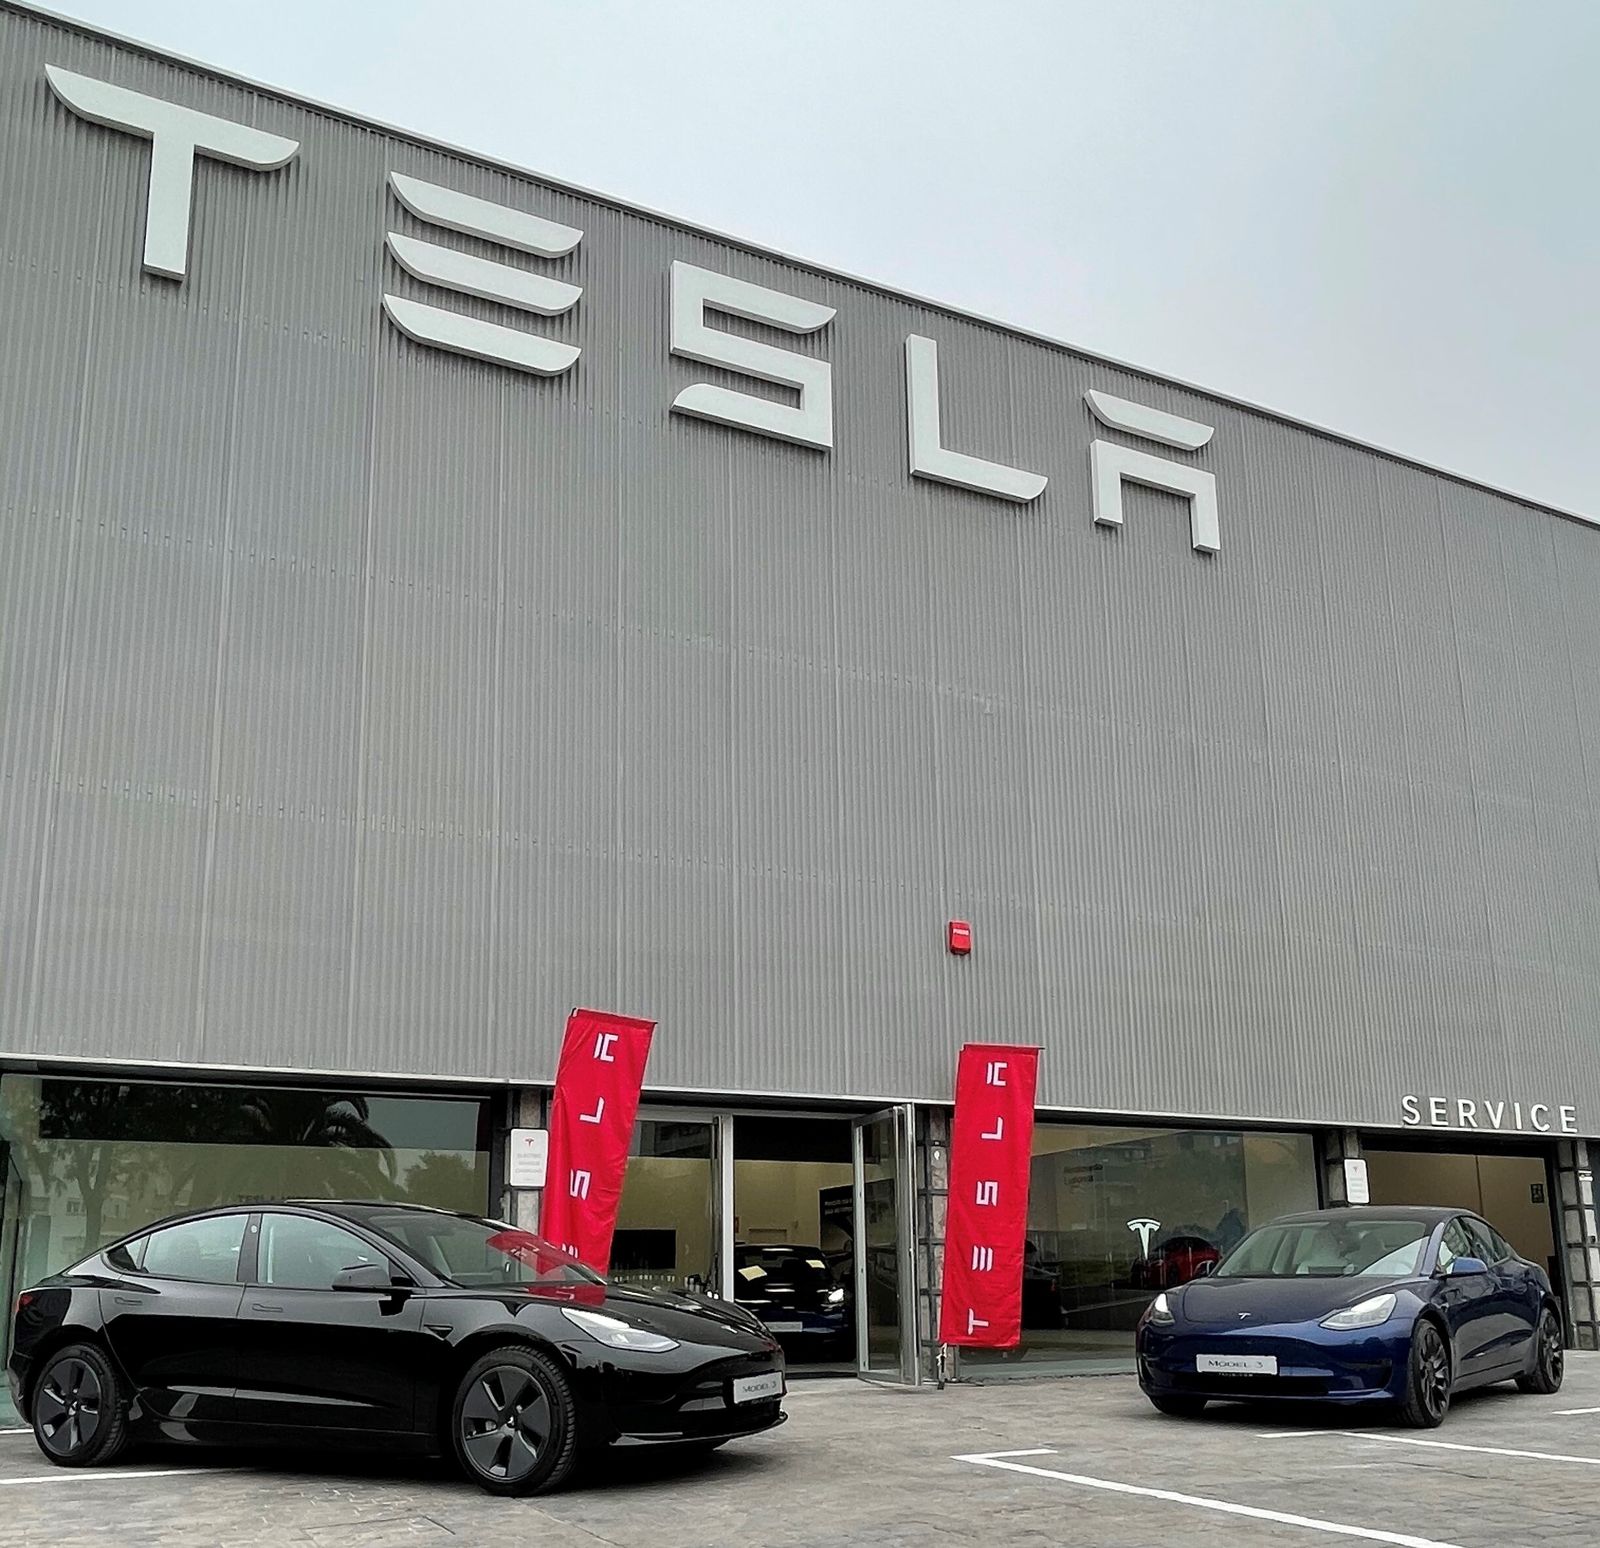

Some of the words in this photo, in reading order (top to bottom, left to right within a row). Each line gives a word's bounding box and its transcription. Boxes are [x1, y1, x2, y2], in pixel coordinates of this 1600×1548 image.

[44, 64, 1221, 553] TESLA
[967, 1062, 1007, 1336] TESLA
[1402, 1095, 1578, 1134] SERVICE
